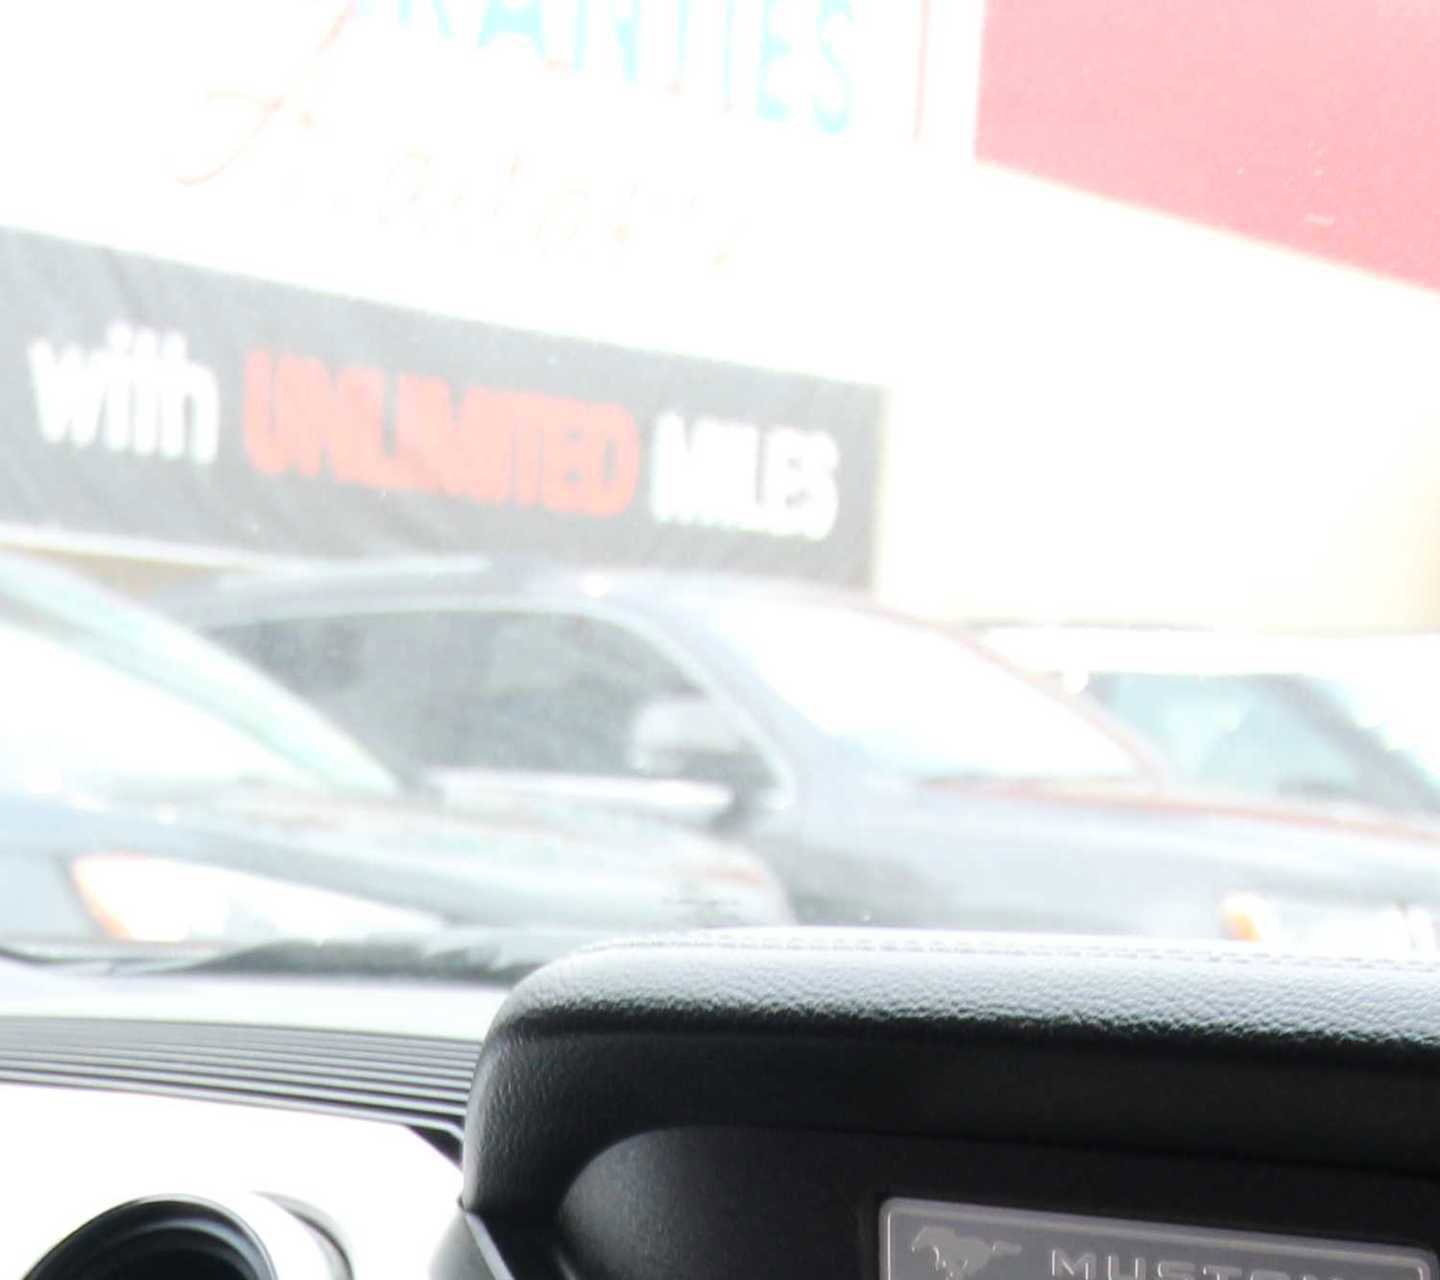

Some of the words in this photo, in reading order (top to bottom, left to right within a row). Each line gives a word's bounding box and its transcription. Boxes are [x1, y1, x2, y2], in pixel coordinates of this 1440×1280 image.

[28, 324, 218, 465] with
[244, 347, 640, 517] UNLIMITED
[651, 411, 840, 542] MILES
